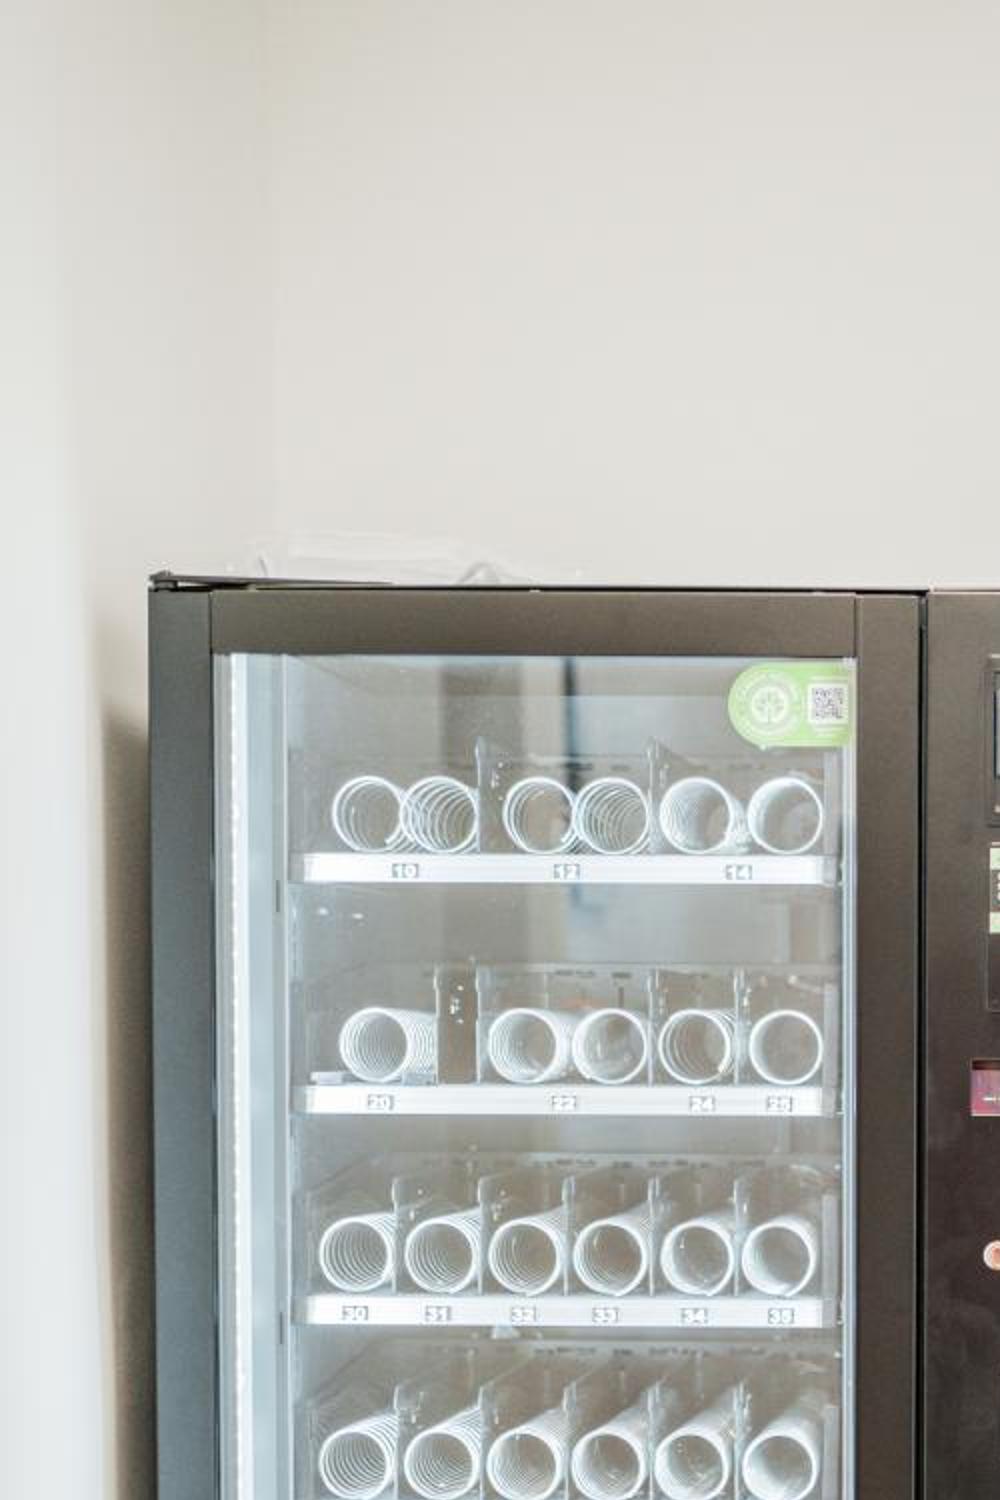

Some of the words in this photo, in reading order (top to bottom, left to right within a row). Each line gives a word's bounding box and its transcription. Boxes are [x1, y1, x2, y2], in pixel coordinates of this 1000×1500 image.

[393, 864, 419, 878] 10
[555, 864, 581, 878] 12
[727, 865, 752, 879] 14
[691, 1097, 715, 1111] 24
[426, 1307, 451, 1320] 31
[682, 1309, 708, 1323] 34
